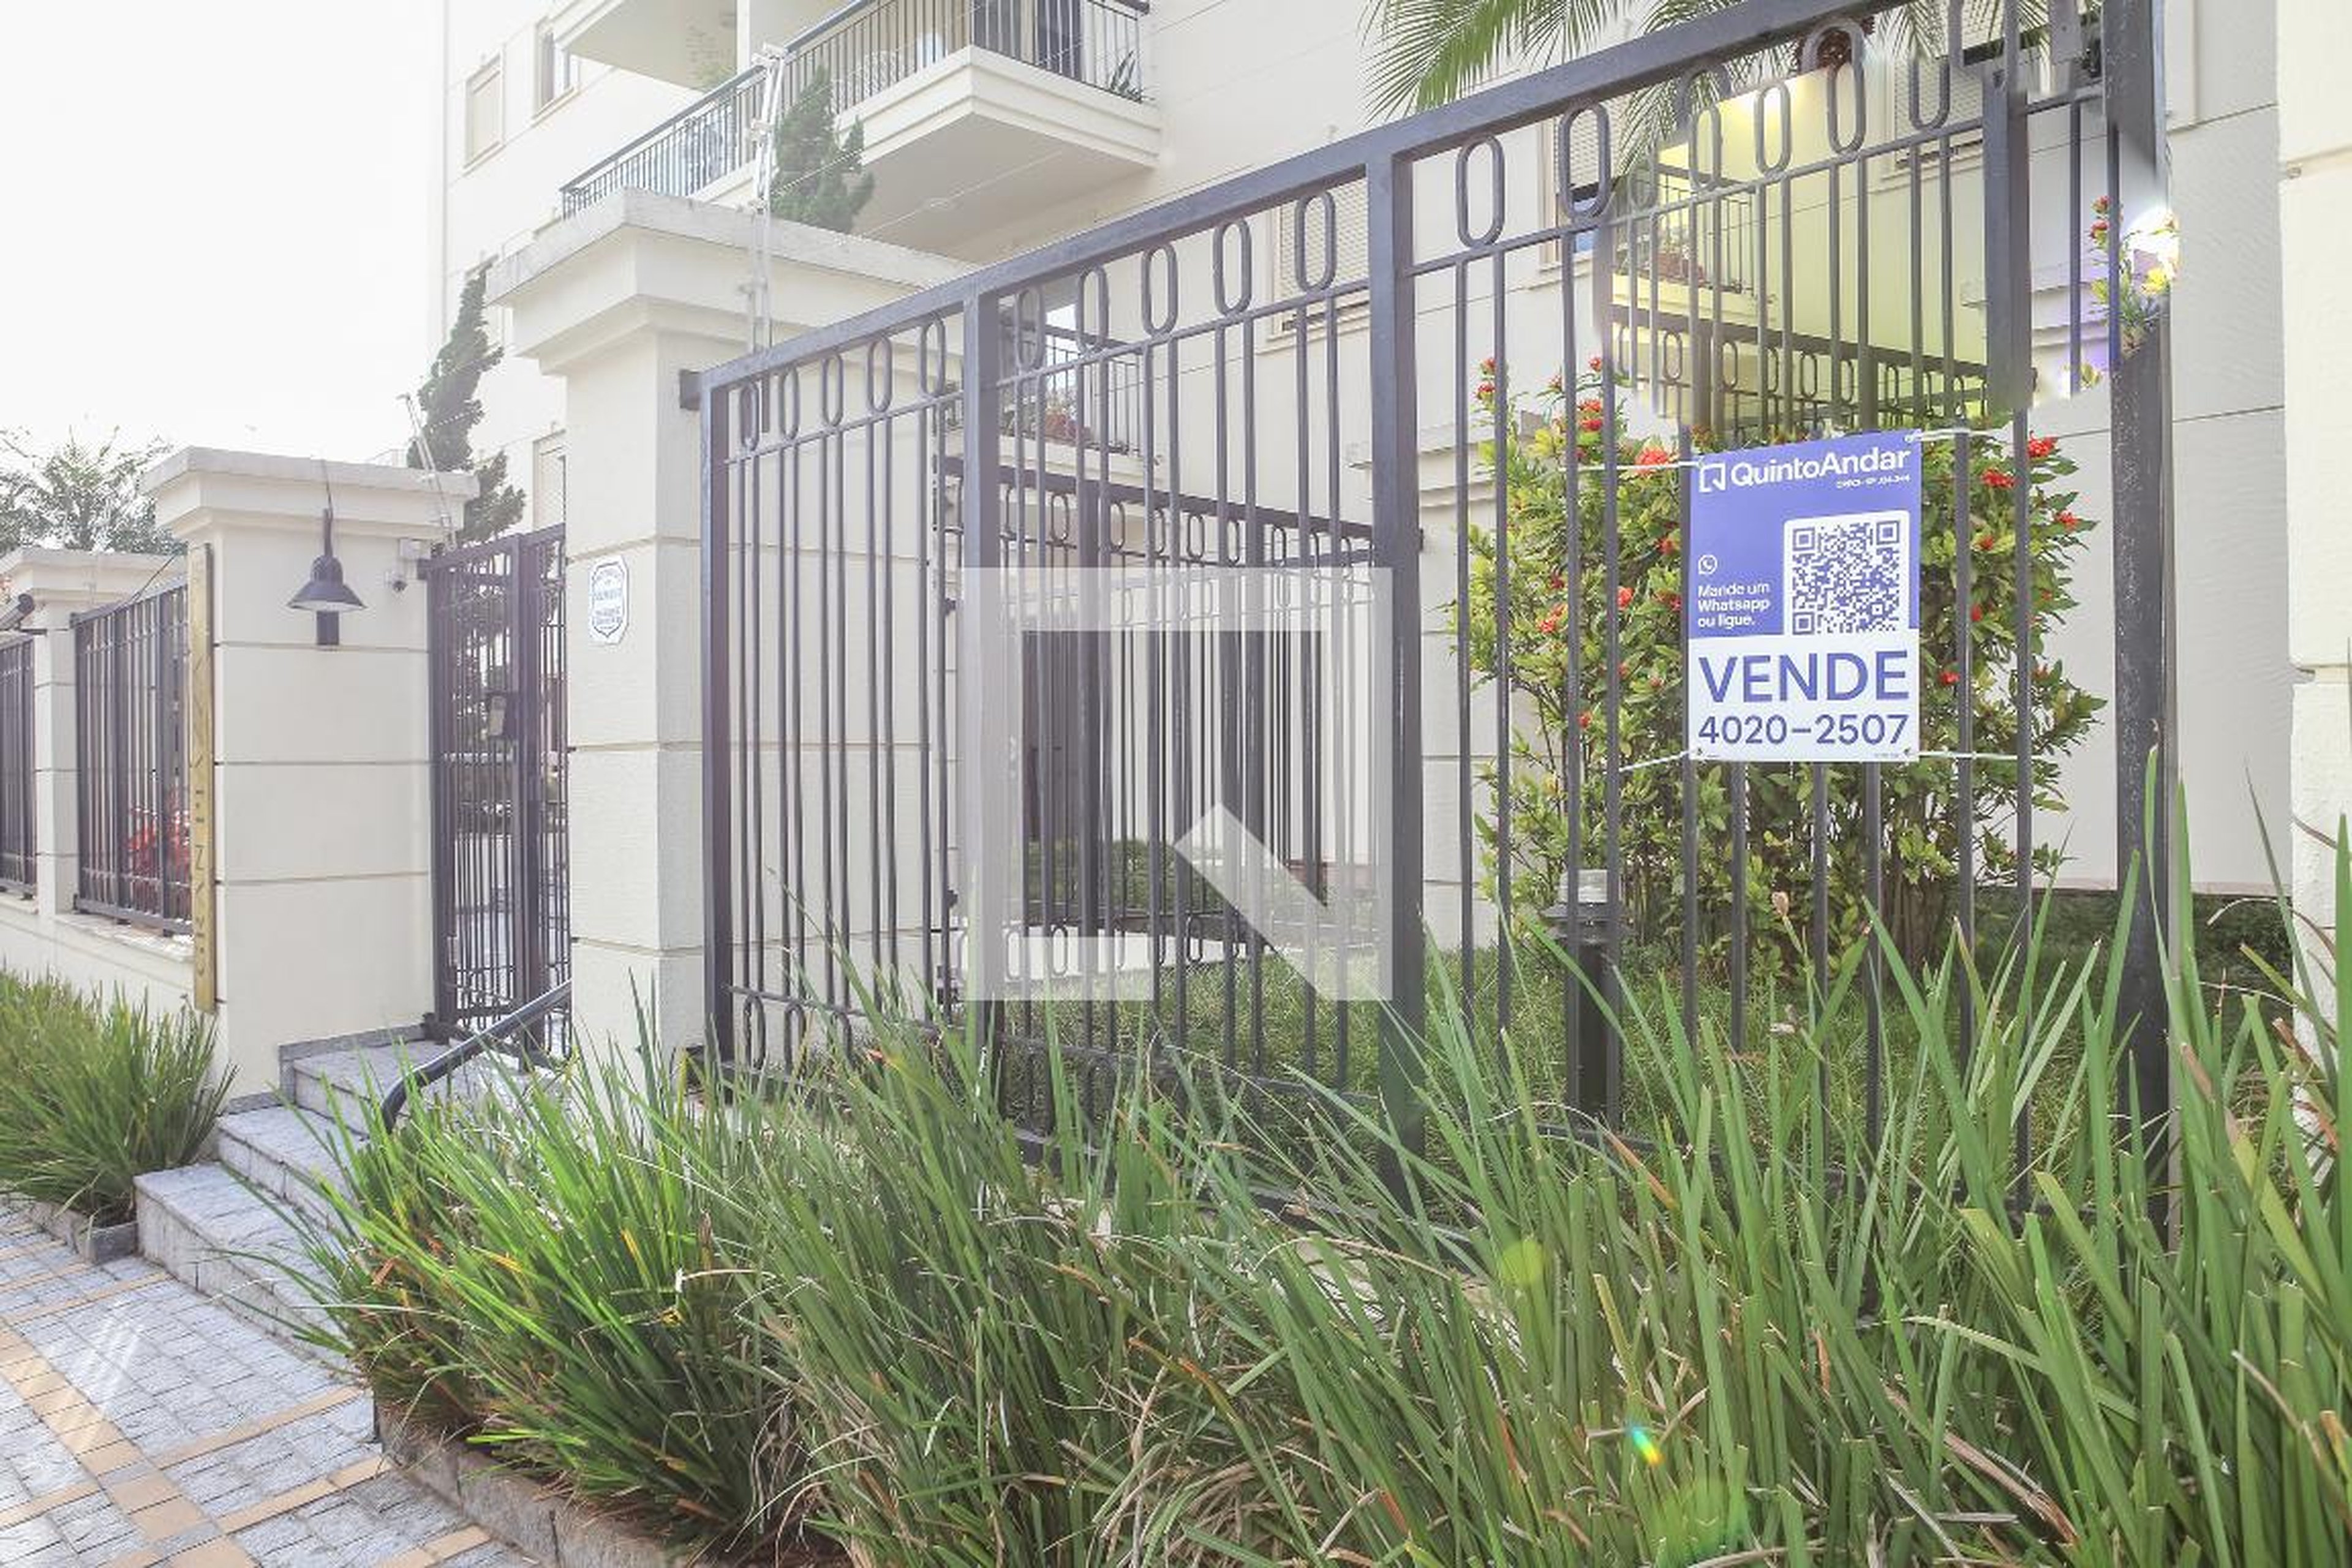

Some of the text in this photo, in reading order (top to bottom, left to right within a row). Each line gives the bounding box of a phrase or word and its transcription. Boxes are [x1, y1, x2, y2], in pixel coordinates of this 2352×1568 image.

[1731, 447, 1910, 486] QuintoAndar
[1698, 583, 1770, 597] Mande um
[1698, 599, 1771, 613] Whatsapp
[1698, 614, 1755, 630] ou ligue.
[1698, 650, 1909, 703] VENDE
[1698, 714, 1909, 744] 4020-2507
